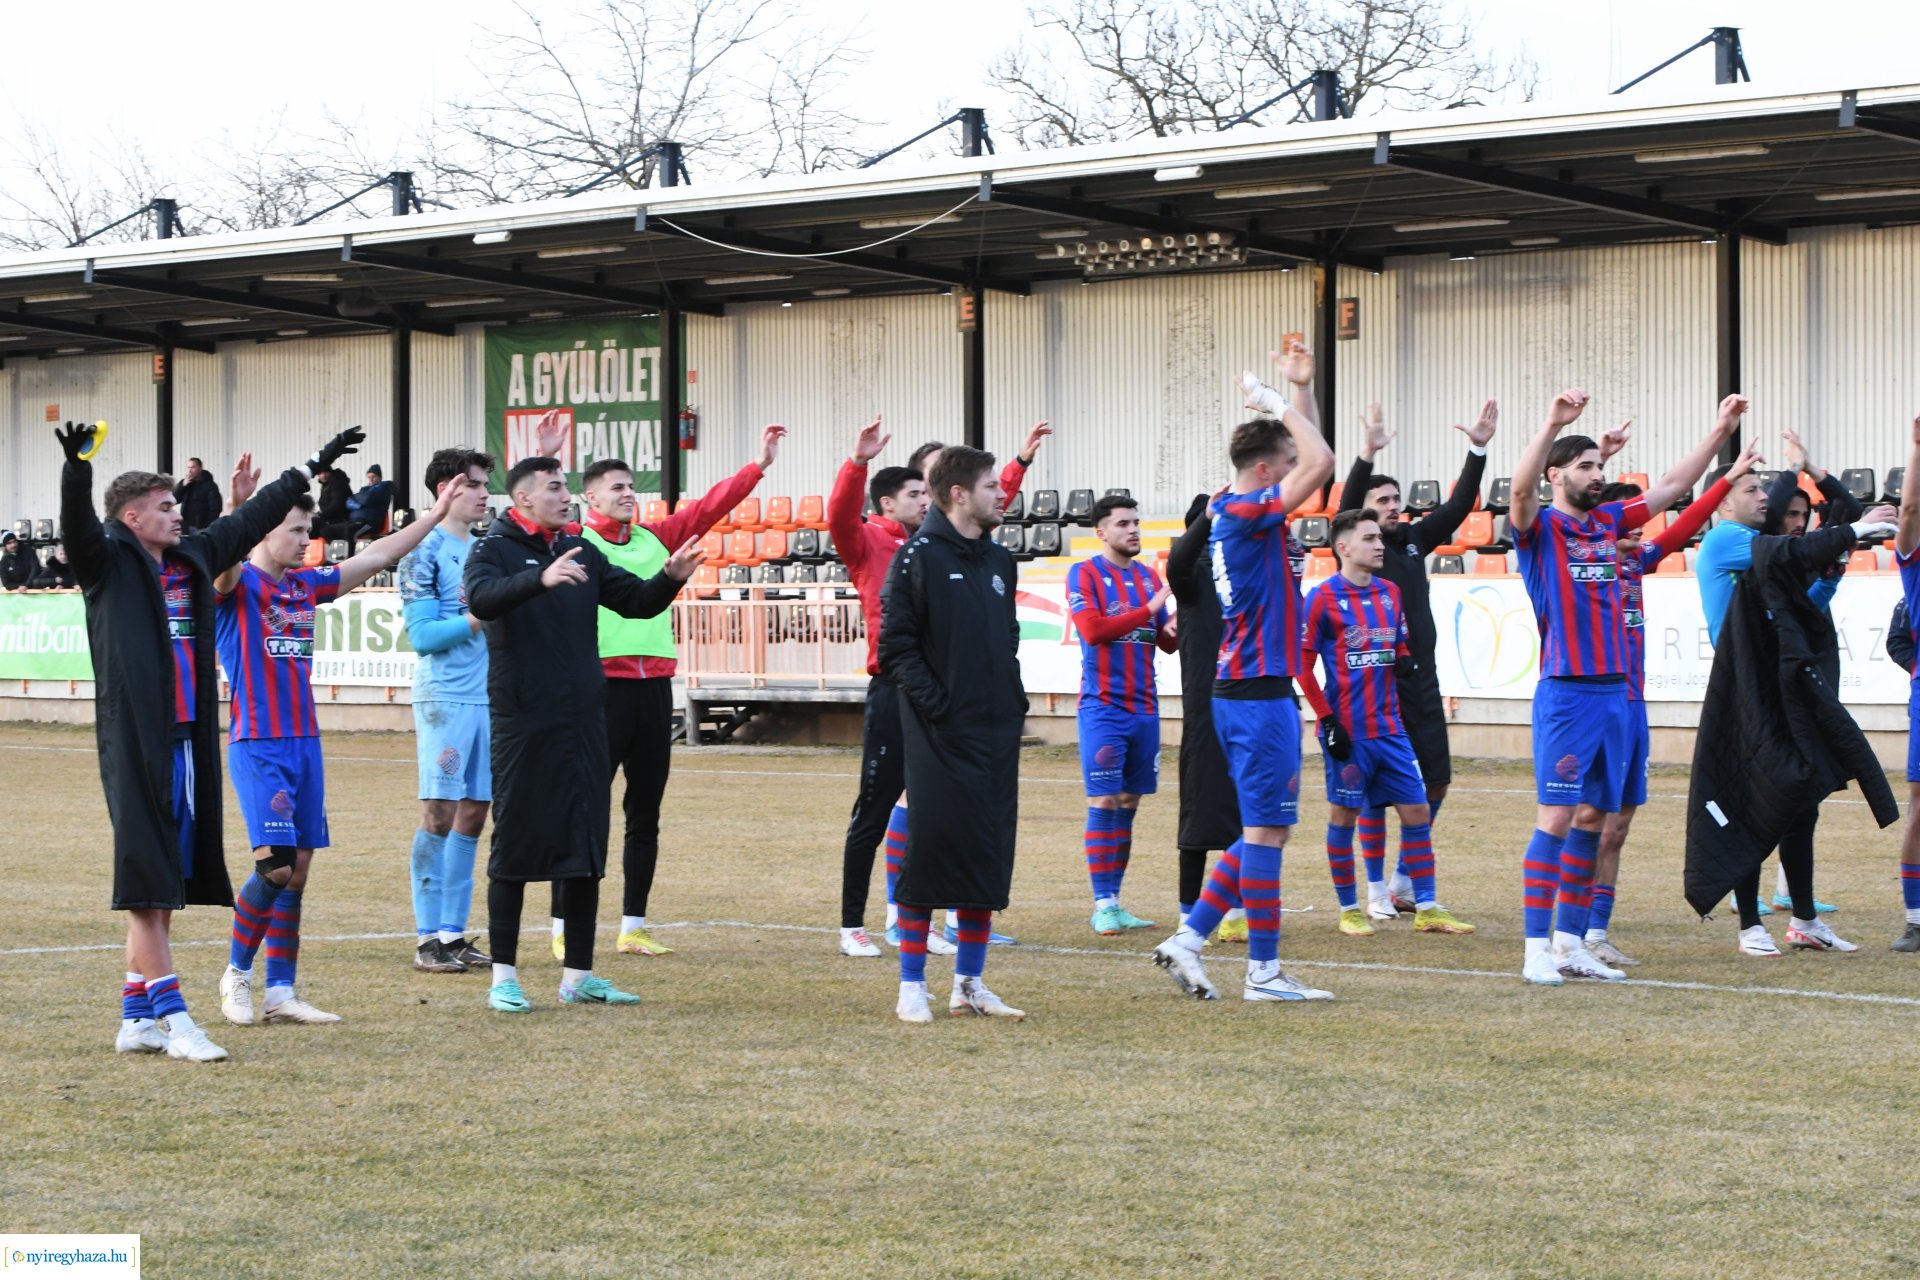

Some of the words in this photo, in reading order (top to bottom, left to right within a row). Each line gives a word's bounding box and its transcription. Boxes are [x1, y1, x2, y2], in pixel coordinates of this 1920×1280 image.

[961, 296, 974, 320] E
[1341, 302, 1356, 328] F
[154, 354, 165, 374] E
[507, 353, 527, 407] A
